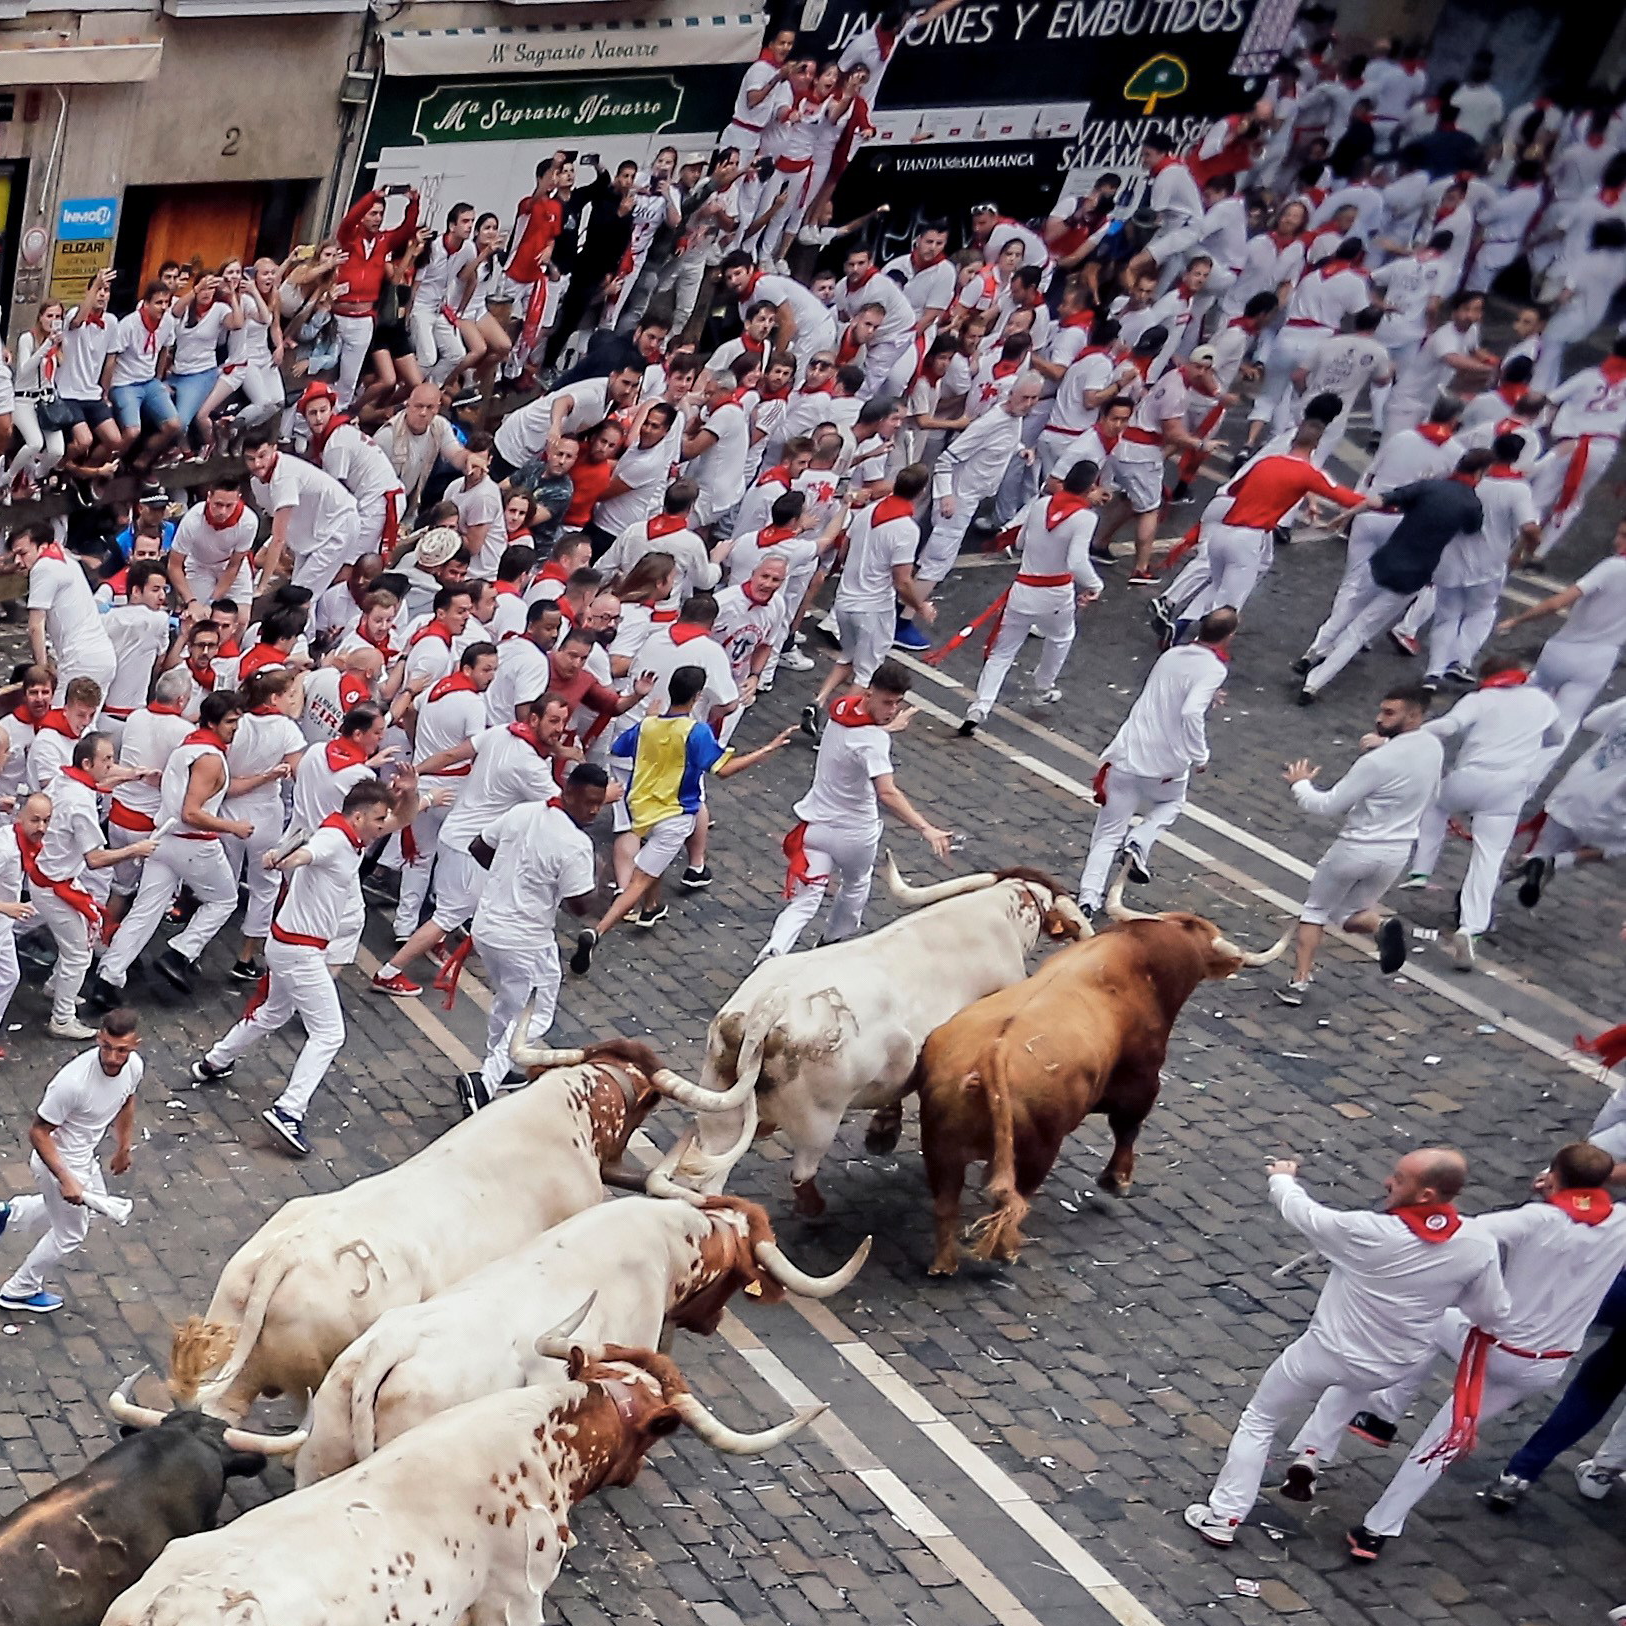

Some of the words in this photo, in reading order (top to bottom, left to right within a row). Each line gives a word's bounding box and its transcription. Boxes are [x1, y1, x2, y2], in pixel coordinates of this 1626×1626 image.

[828, 3, 1000, 50] JAONES
[1014, 3, 1040, 40] Y
[1048, 0, 1244, 40] EMBUTIDOS
[514, 42, 585, 67] Sagrario
[591, 40, 659, 60] Navarro
[480, 98, 570, 131] Sagrario
[574, 95, 661, 124] Navarro
[221, 127, 240, 156] 2
[62, 242, 105, 255] ELIZARI
